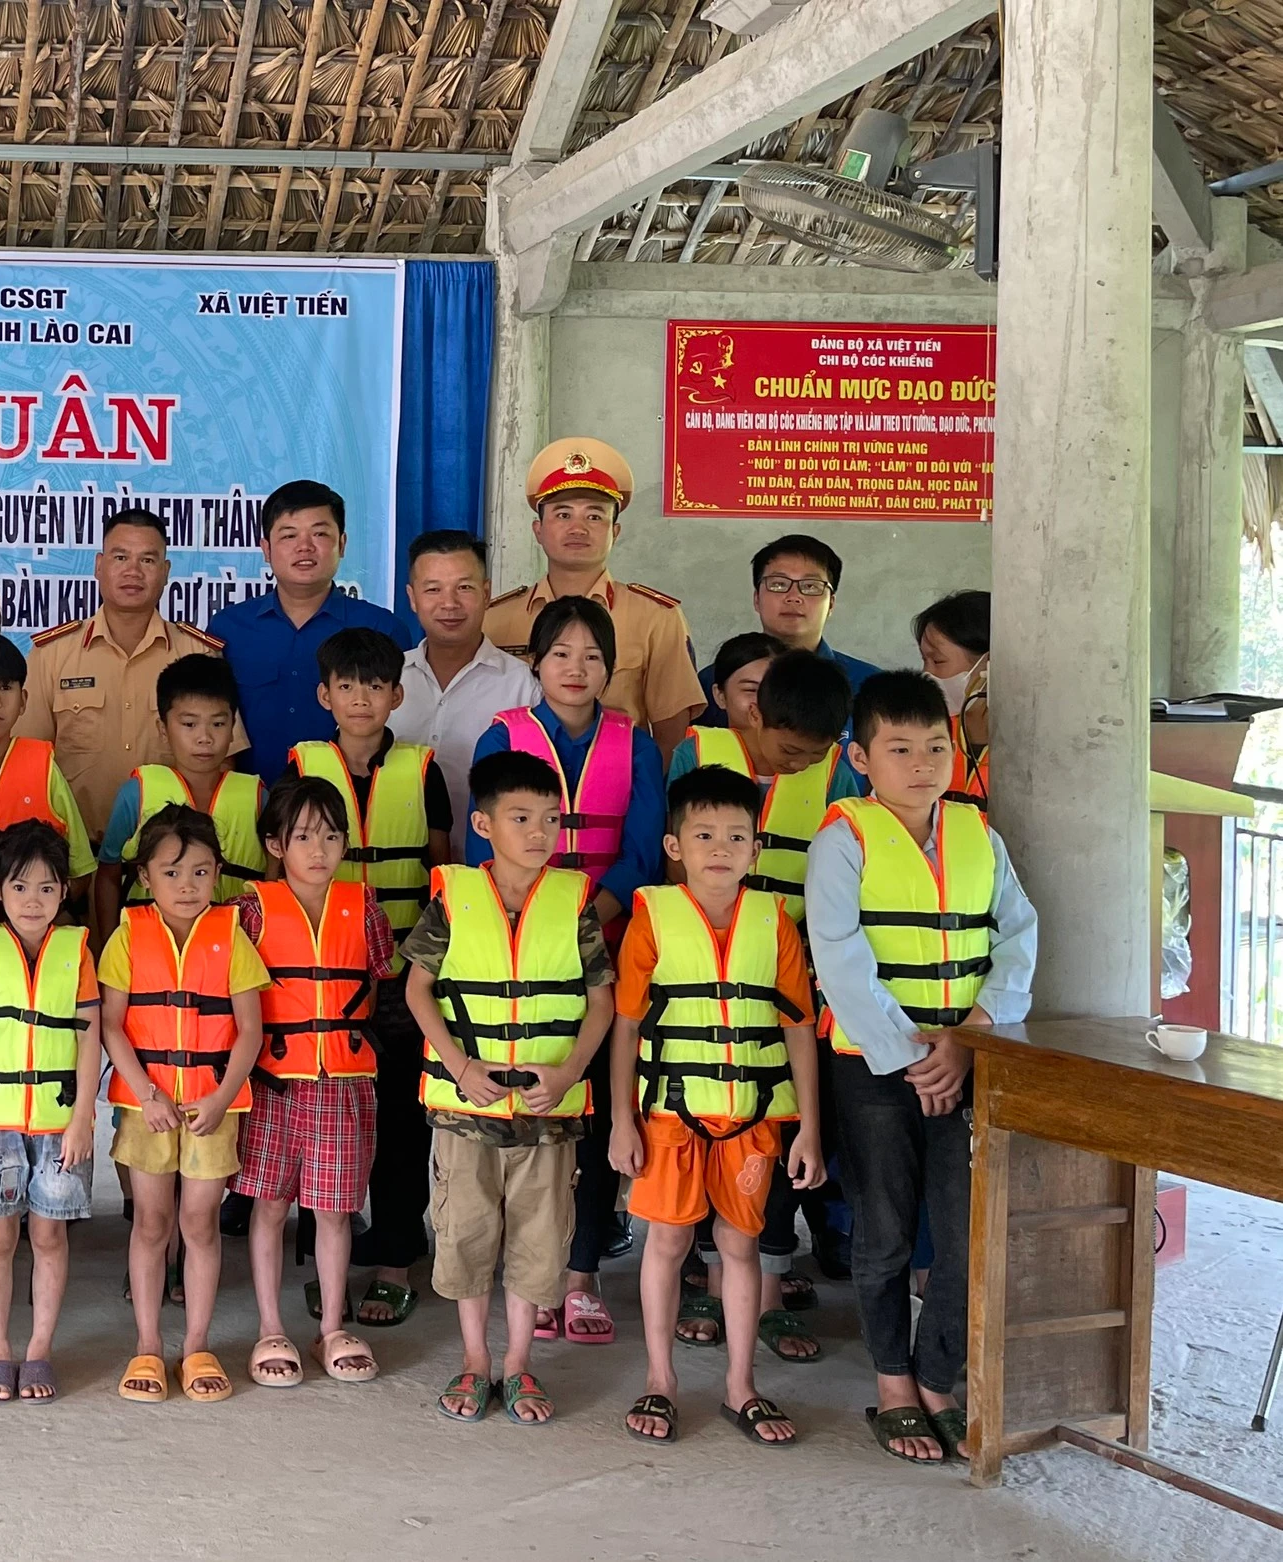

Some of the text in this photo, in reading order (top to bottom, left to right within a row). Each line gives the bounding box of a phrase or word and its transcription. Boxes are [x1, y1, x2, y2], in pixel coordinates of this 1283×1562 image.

[0, 288, 67, 309] CSGT
[198, 290, 347, 318] XÃ VIỆT TIẾN
[30, 318, 78, 343] LÀO
[88, 323, 131, 345] CAI
[811, 335, 941, 353] ĐẢNG BỘ XÃ VIỆT TIẾN
[819, 355, 839, 366] CHI
[842, 354, 858, 368] BỘ
[862, 353, 886, 367] CÓC
[755, 369, 996, 405] CHUẨN MỰC ĐẠO ĐỨC
[685, 409, 701, 429] CÁN
[736, 409, 753, 430] VIÊN
[755, 413, 767, 430] CHI
[768, 410, 778, 433] BỘ
[824, 414, 838, 434] HỌC
[883, 415, 900, 432] THEO
[747, 435, 772, 452] BẢN
[804, 439, 839, 453] CHÍNH
[842, 441, 860, 456] TRỊ
[863, 439, 894, 454] VỮNG
[821, 456, 840, 471] VỚI
[746, 476, 766, 488] TIN
[856, 478, 894, 492] TRỌNG
[927, 479, 951, 494] HỌC
[953, 477, 978, 492] DÂN
[808, 492, 847, 508] THỐNG
[885, 494, 910, 509] DÂN
[942, 496, 972, 510] PHÁT
[73, 486, 94, 545] VÌ
[159, 498, 193, 547] EM
[201, 489, 262, 548] THÂN
[2, 568, 50, 628] BÀN
[169, 577, 203, 627] CƯ
[736, 1154, 767, 1195] 8
[901, 1418, 917, 1426] VIP
